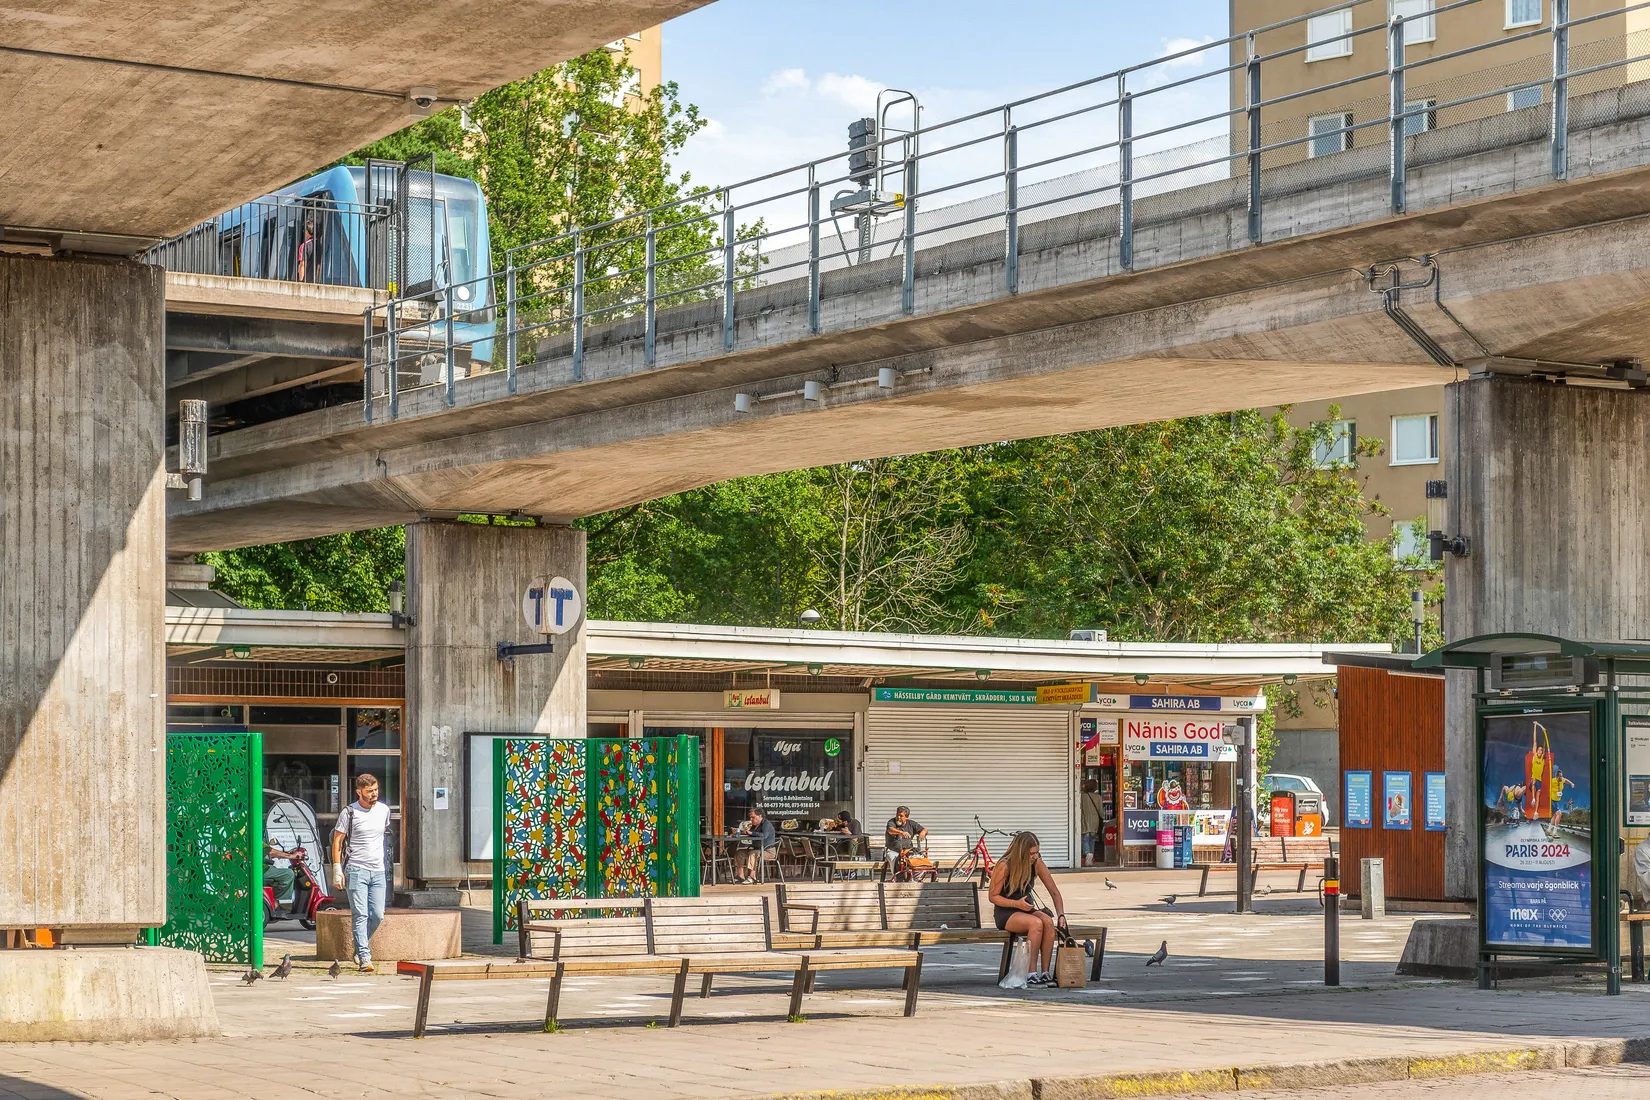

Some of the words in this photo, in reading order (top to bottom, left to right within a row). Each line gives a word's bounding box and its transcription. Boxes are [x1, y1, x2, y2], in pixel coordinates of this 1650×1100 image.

[550, 587, 573, 626] T
[893, 690, 925, 700] HÄSSELLBY
[925, 692, 942, 700] GÅRD
[943, 693, 971, 701] KEMTVÄTT
[975, 693, 1008, 702] SKRÄDDERI,
[1151, 698, 1186, 709] SAHIRA
[1187, 699, 1200, 709] AB
[1232, 699, 1248, 708] Lyca
[1128, 721, 1177, 739] Nänis
[773, 740, 802, 756] Nya
[1125, 743, 1141, 752] Lyca
[1155, 744, 1188, 755] SAHIRA
[1190, 744, 1203, 755] AB
[1212, 744, 1228, 753] Lyca
[744, 770, 834, 792] istanbul
[1128, 818, 1150, 830] Lyca
[1505, 844, 1538, 858] PARIS
[1541, 844, 1570, 858] 2024
[1498, 880, 1526, 889] Streama
[1526, 881, 1544, 891] varje
[1544, 880, 1579, 892] ögonblick
[1510, 908, 1538, 921] max
